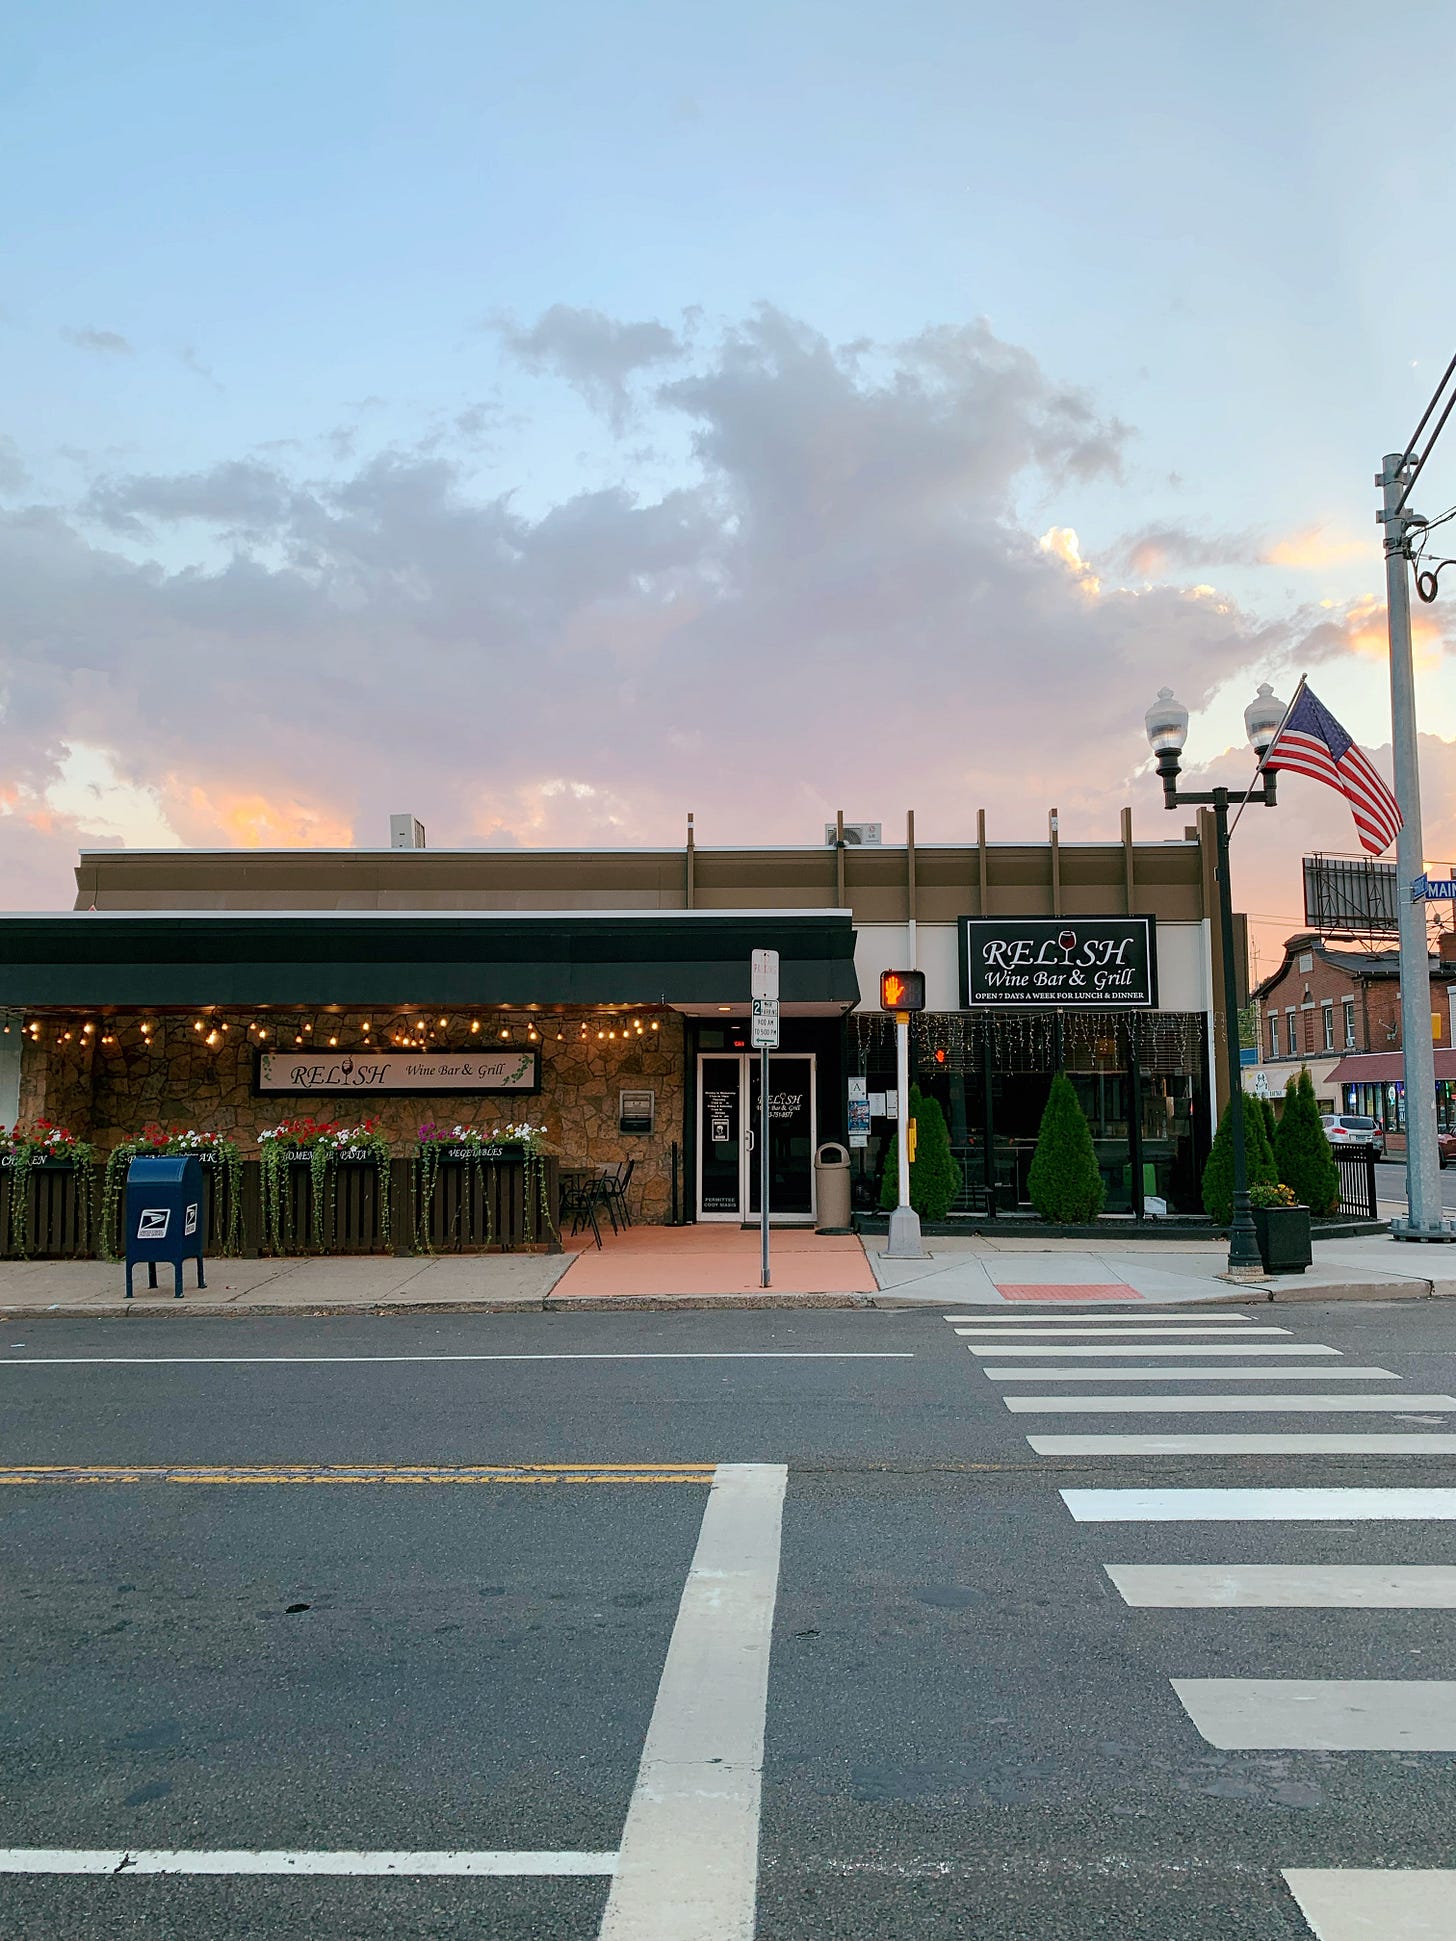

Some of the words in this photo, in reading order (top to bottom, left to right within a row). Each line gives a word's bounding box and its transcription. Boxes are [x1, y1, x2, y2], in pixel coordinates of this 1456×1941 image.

[982, 931, 1134, 969] RELISH
[984, 971, 1029, 987] Wine
[1033, 971, 1067, 986] Bar
[1068, 968, 1087, 986] &
[1094, 968, 1136, 991] Grill
[975, 992, 998, 1000] OPEN
[1111, 991, 1145, 999] DINNER
[754, 1002, 761, 1015] 2
[290, 1056, 392, 1088] RELISH
[405, 1064, 435, 1076] Wine
[438, 1064, 461, 1076] Bar
[461, 1063, 473, 1076] &
[478, 1063, 506, 1079] Grill
[340, 1150, 367, 1161] PASTA
